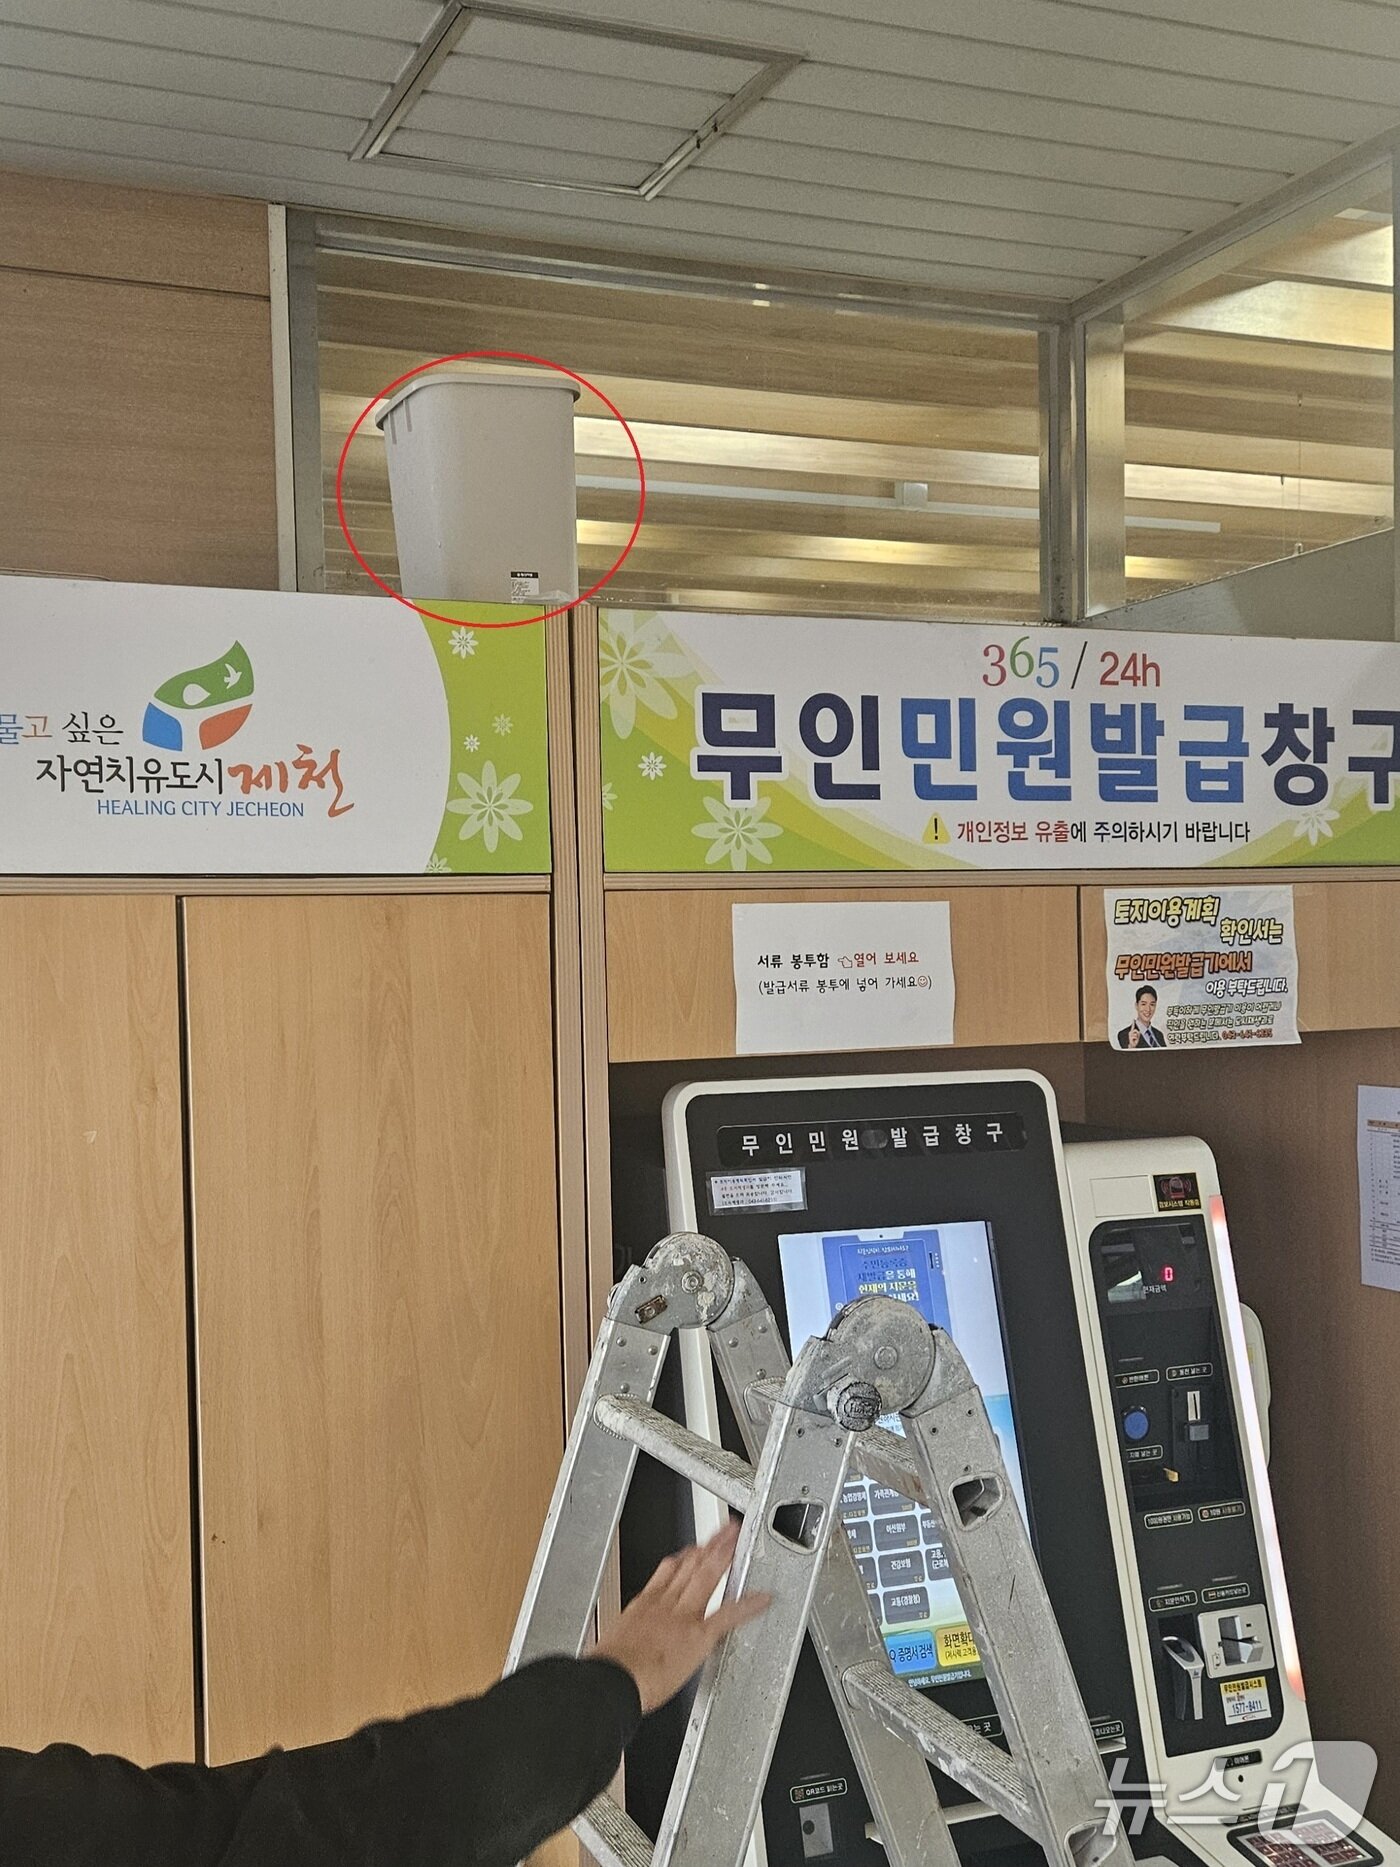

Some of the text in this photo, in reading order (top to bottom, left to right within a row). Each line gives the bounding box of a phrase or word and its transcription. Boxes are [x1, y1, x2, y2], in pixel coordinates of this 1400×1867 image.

[982, 636, 1060, 690] 365
[1099, 651, 1161, 689] 24h
[62, 712, 124, 745] 싶은
[695, 692, 1400, 806] 무인민원발급창구
[36, 743, 354, 818] 자연치유도시 제천
[97, 799, 304, 818] HEALING CITY JECHEON
[957, 820, 1251, 844] 개인정보 유출에 주의하시기 바랍니다
[1114, 895, 1220, 928] 토지이용계획
[1220, 917, 1283, 945] 확인서는
[757, 951, 919, 969] 서류 봉투함 열어 보세요
[1114, 951, 1252, 981] 무인민원발급기에서
[758, 980, 810, 995] (발급서류
[816, 978, 850, 993] 봉투에
[856, 977, 878, 992] 넣어
[1205, 977, 1288, 997] 이용 부탁드립니다.
[1164, 1267, 1174, 1281] 0
[983, 1721, 991, 1732] 곳
